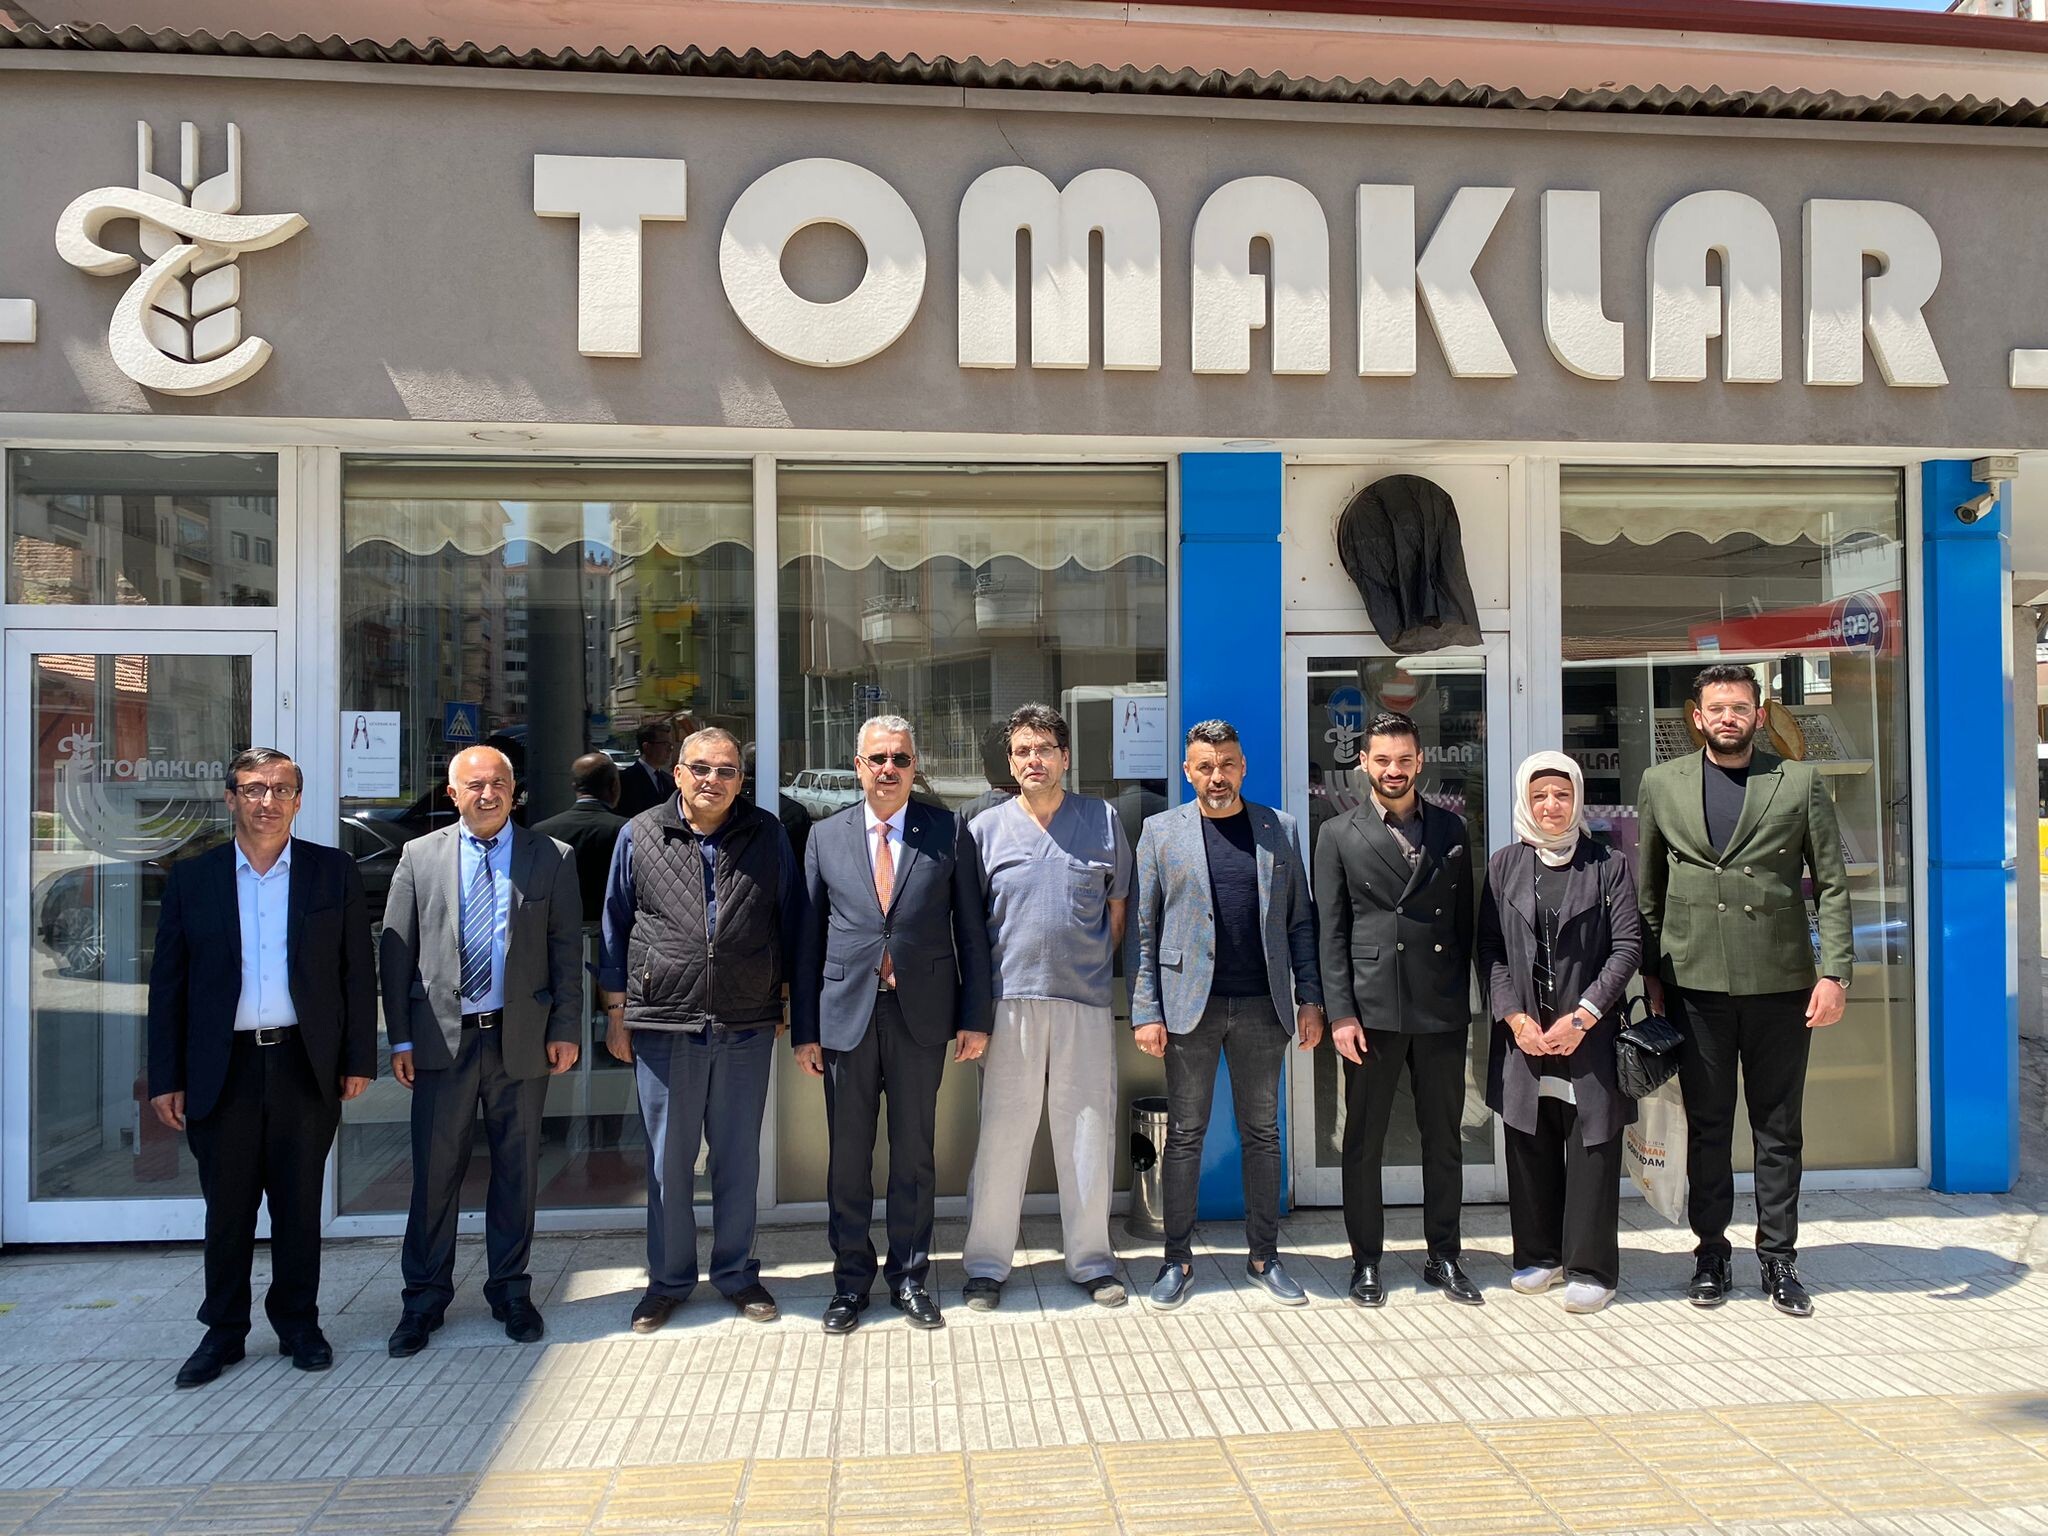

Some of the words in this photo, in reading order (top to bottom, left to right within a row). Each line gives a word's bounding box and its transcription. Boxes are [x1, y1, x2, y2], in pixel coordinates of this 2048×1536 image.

[533, 153, 1949, 387] TOMAKLAR
[1424, 745, 1473, 763] KLAR
[102, 759, 223, 781] TOMAKLAR
